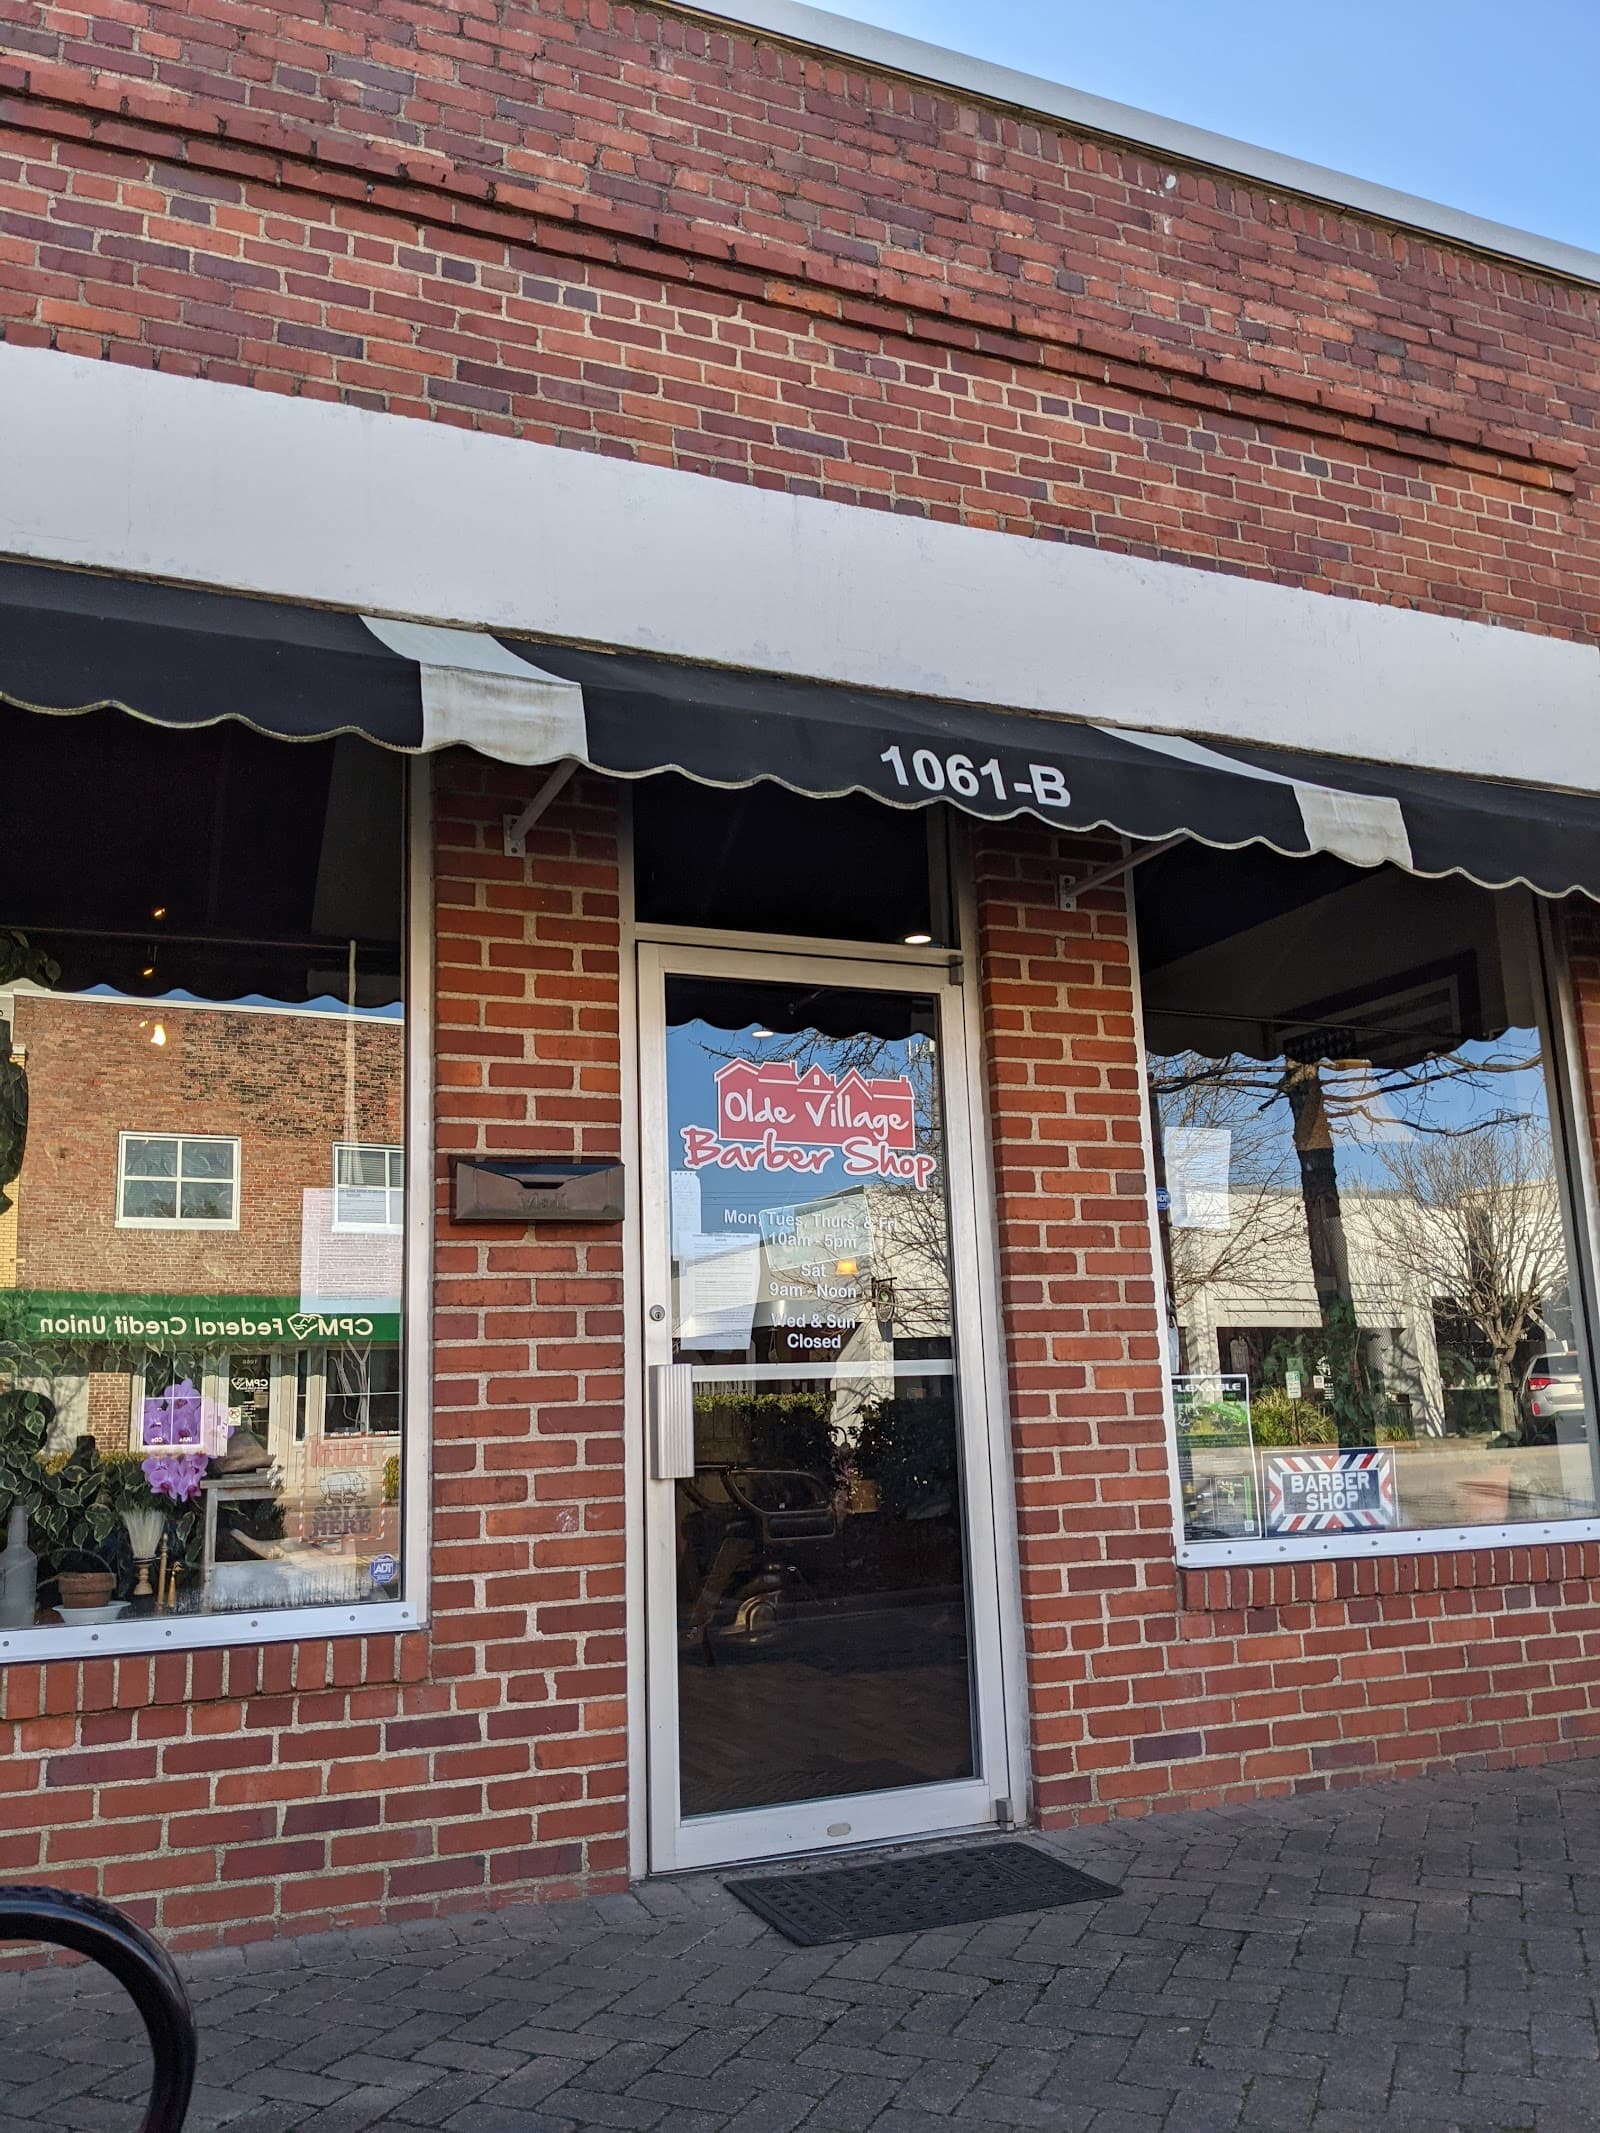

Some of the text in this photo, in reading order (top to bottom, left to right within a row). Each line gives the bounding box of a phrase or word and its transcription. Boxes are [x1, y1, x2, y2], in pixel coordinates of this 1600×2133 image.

[880, 745, 1071, 808] 1061-B
[724, 1091, 909, 1140] Olde Village
[680, 1125, 937, 1191] Barber Shop
[766, 1211, 807, 1229] Tues,
[812, 1213, 859, 1231] Thurs,
[879, 1217, 898, 1231] Fri
[769, 1231, 811, 1247] 10am
[824, 1233, 857, 1249] 5pm
[801, 1263, 826, 1277] Sat
[769, 1282, 803, 1297] 9am
[816, 1283, 857, 1298] Noon
[771, 1312, 856, 1329] Wed & Sun
[787, 1333, 842, 1349] Closed
[1290, 1471, 1370, 1493] BARBER
[1305, 1490, 1359, 1511] SHOP
[313, 1505, 371, 1521] SOLD
[311, 1519, 372, 1537] HERE
[373, 1562, 393, 1575] ADT
